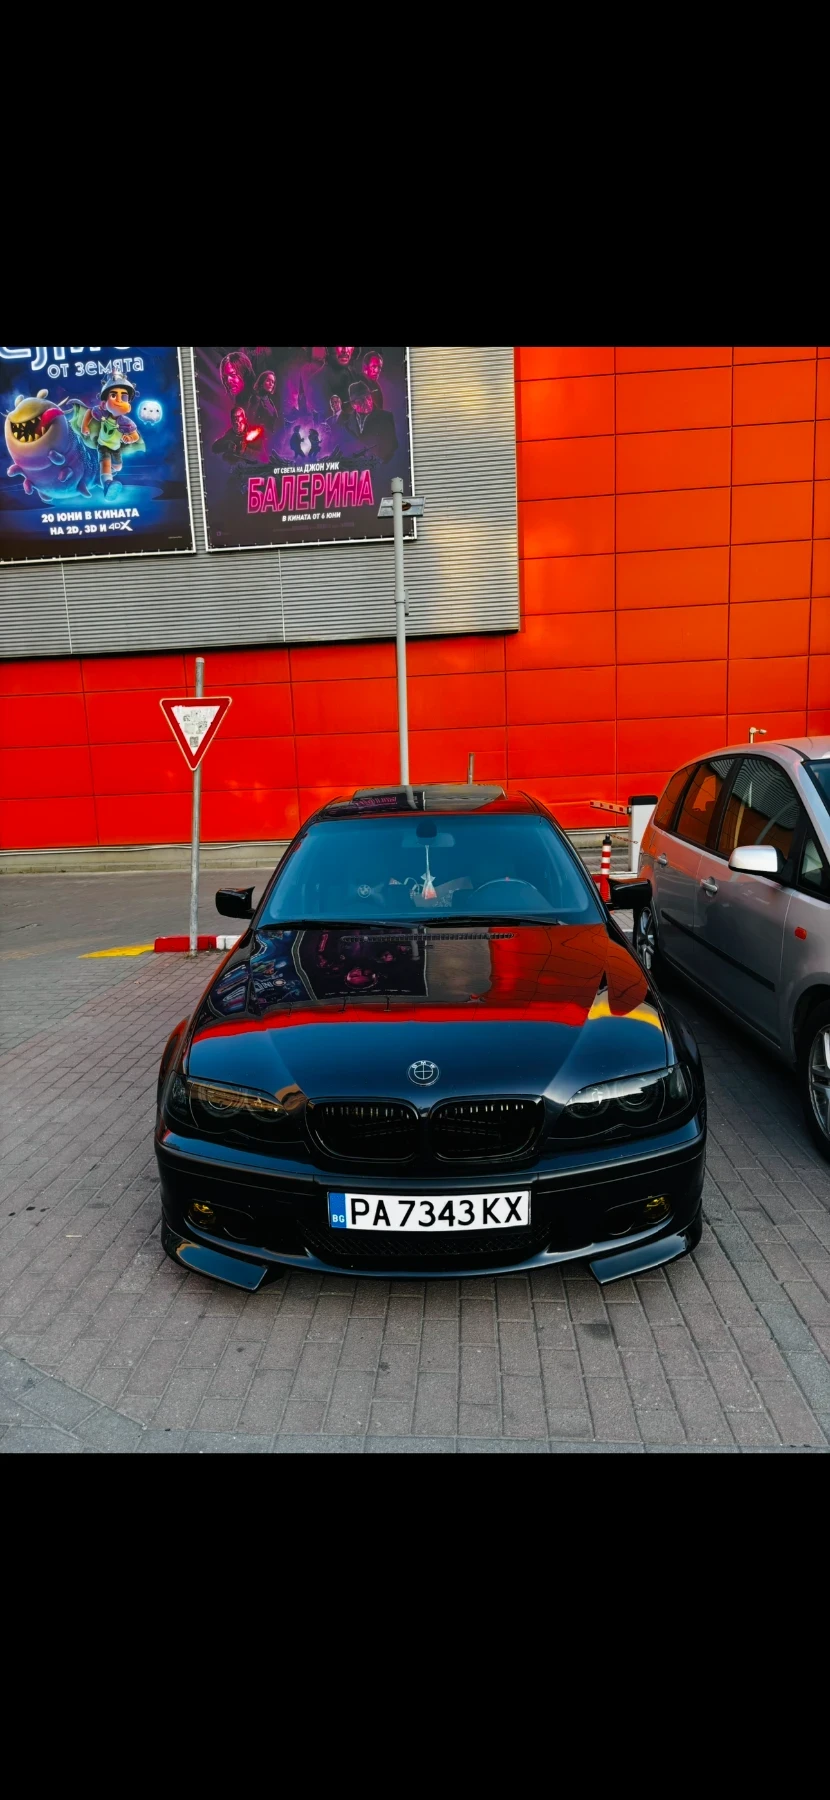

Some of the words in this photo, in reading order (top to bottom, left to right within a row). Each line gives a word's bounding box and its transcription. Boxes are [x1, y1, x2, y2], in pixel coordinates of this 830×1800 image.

[273, 467, 281, 475] ОТ
[281, 465, 296, 474] СВЕТА
[296, 465, 304, 473] НА
[303, 463, 325, 473] ДЖОН
[325, 462, 340, 471] УИК
[247, 469, 375, 514] БАЛЕРИНА
[41, 513, 54, 523] 20
[57, 511, 83, 523] ЮНИ
[85, 511, 92, 520] В
[94, 508, 140, 519] КИНАТА
[288, 514, 312, 522] КИНАТА
[326, 511, 341, 519] ЮНИ
[50, 526, 65, 535] НА
[66, 525, 83, 536] 2D,
[84, 524, 98, 534] 3D
[99, 523, 107, 532] И
[108, 520, 134, 532] 4DX
[332, 1214, 345, 1223] BG
[350, 1198, 391, 1227] PA
[398, 1199, 476, 1228] 7343
[482, 1195, 523, 1225] KX
